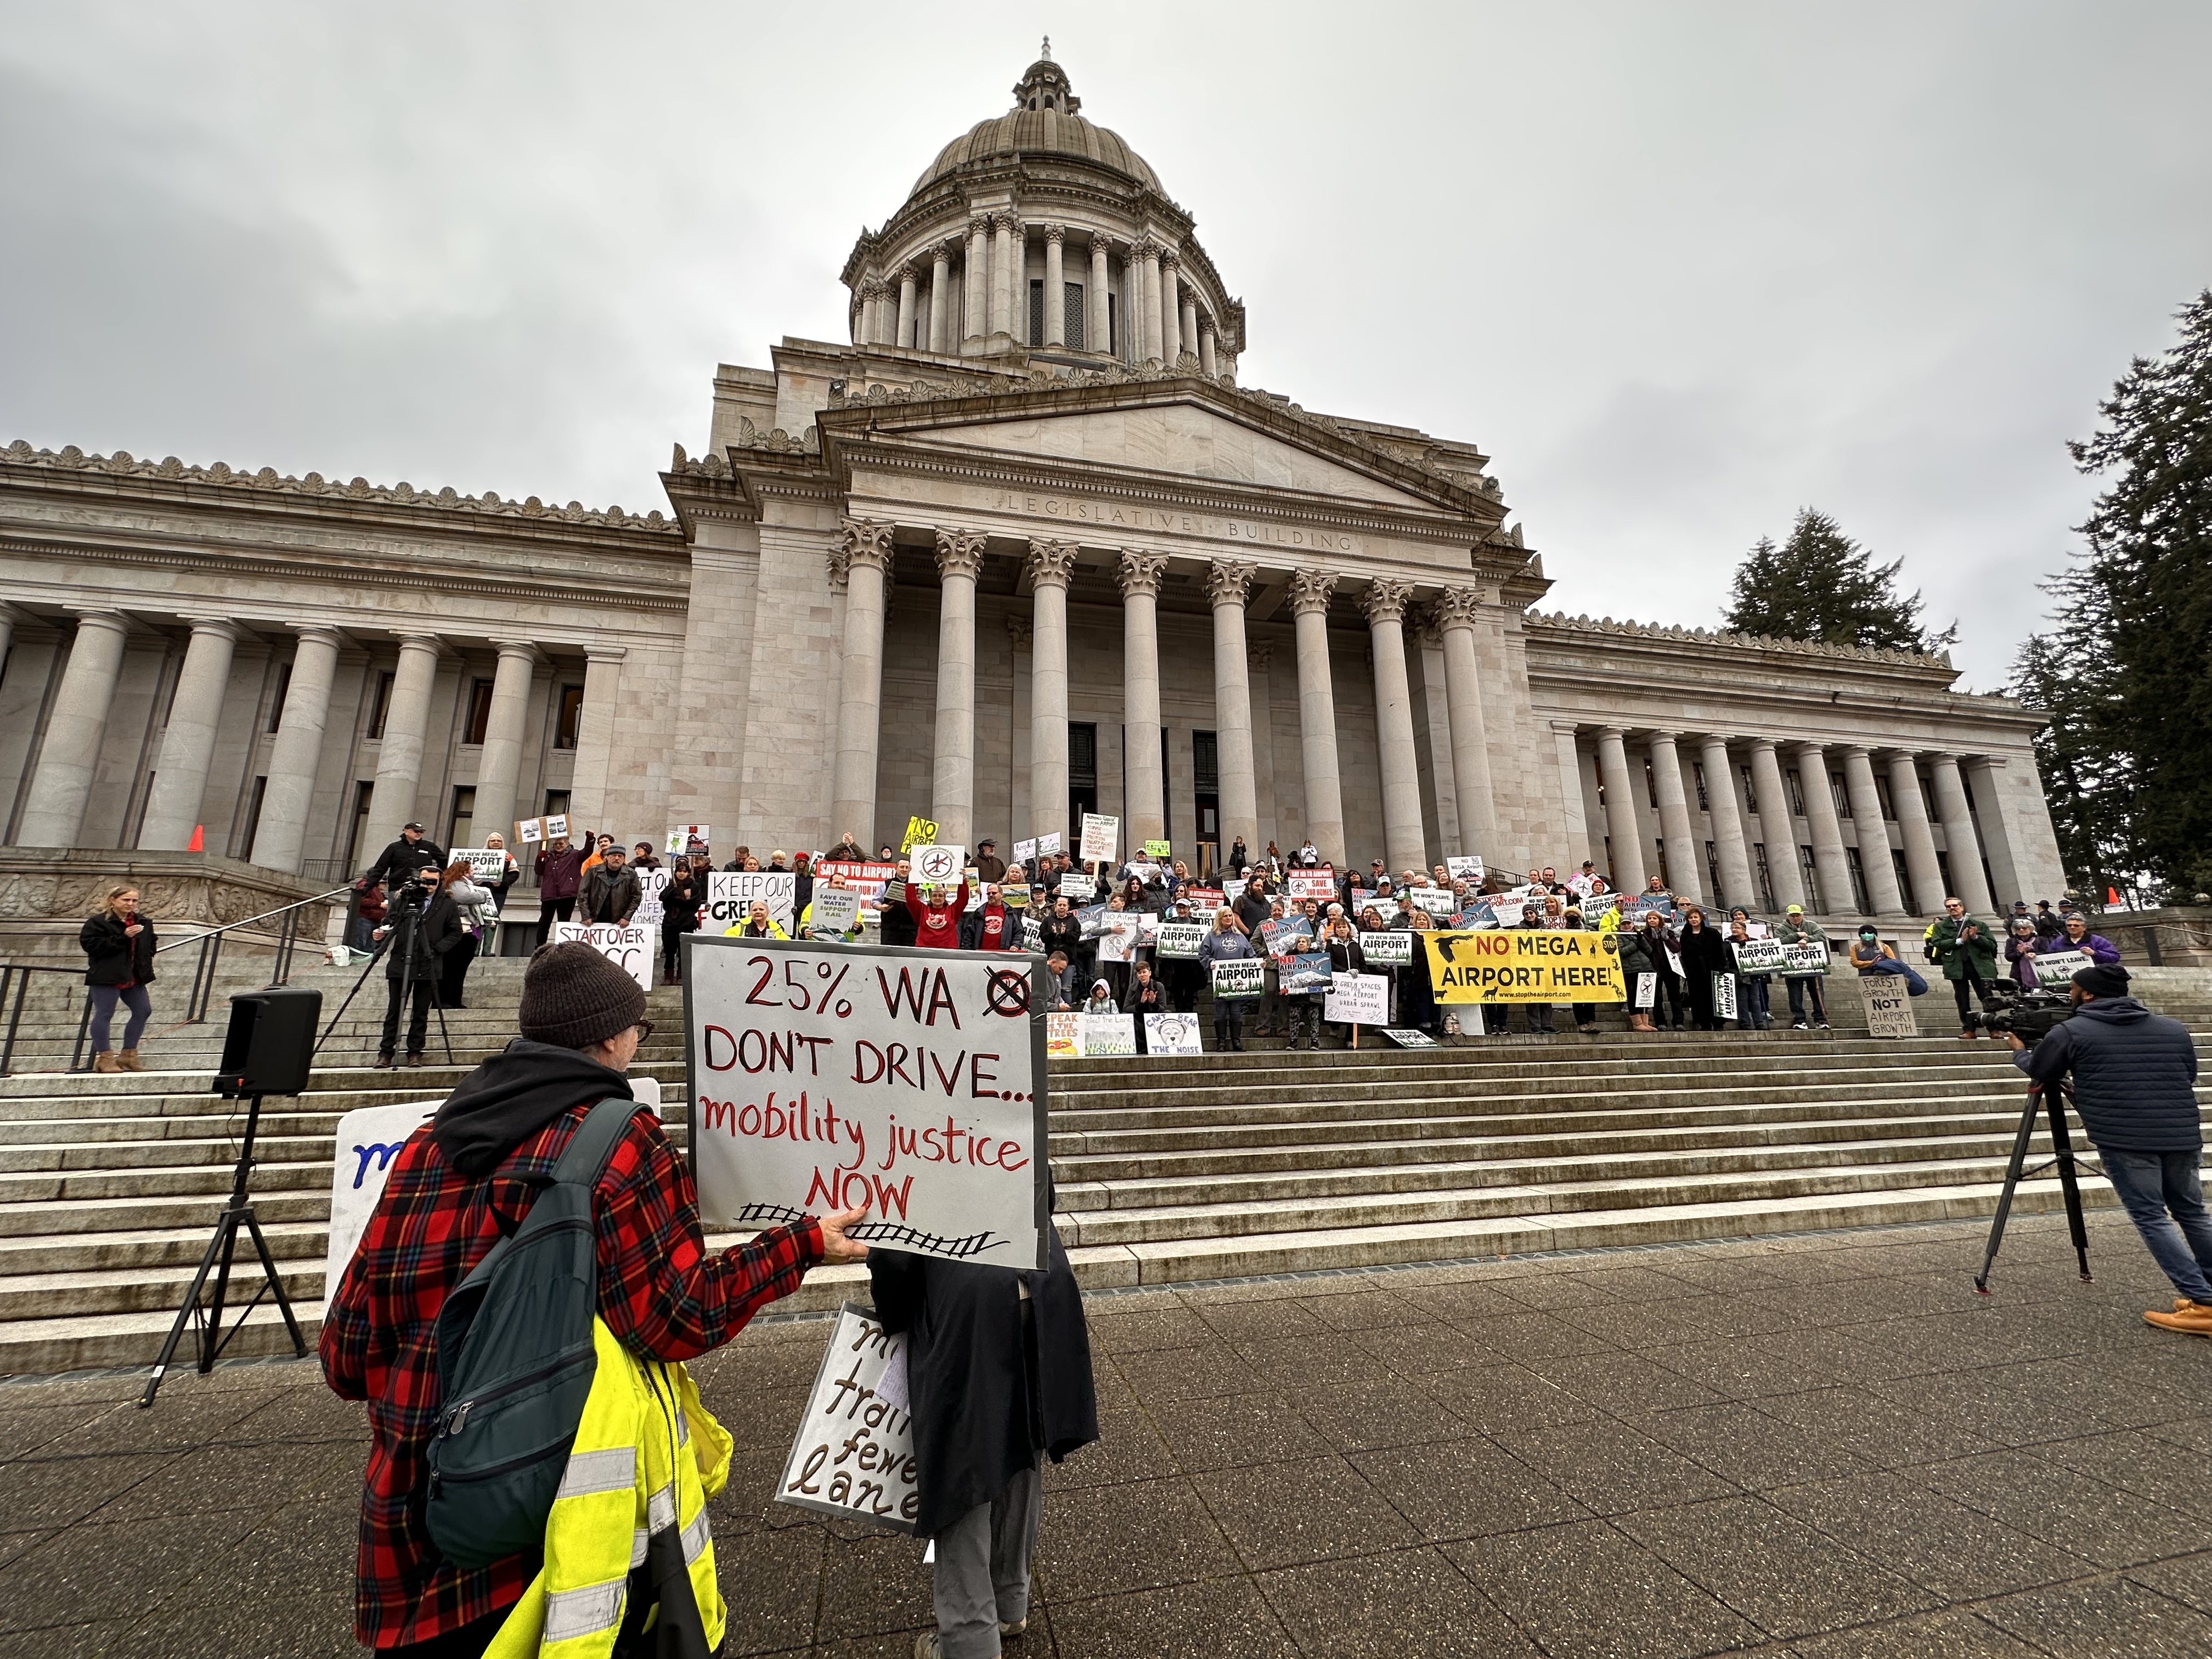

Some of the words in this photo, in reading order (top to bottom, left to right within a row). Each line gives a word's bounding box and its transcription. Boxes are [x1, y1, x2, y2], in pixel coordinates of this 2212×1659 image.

[1007, 494, 1192, 531] LEGISLATIVE
[1229, 523, 1351, 551] BUILDING
[913, 818, 936, 837] NO
[820, 863, 837, 876] SAY
[838, 865, 849, 877] NO
[850, 865, 861, 878] TO
[714, 876, 763, 898] KEEP
[765, 877, 793, 898] OUR
[859, 885, 871, 895] OUR
[711, 900, 768, 921] GRE
[1449, 912, 1464, 924] NO
[1261, 922, 1277, 932] NO
[1265, 926, 1293, 938] AIRPORT
[560, 928, 606, 945] START
[607, 929, 645, 945] OVER
[1160, 932, 1204, 941] AIRPORT
[1363, 940, 1408, 949] AIRPORT
[1476, 935, 1509, 955] NO
[1517, 936, 1582, 956] MEGA
[1603, 940, 1617, 949] STOP
[1738, 946, 1780, 958] AIRPORT
[1279, 956, 1295, 964] NO
[1216, 968, 1261, 980] AIRPORT
[1441, 967, 1544, 986] AIRPORT
[1552, 967, 1611, 986] HERE!
[1863, 977, 1899, 989] FOREST
[745, 956, 853, 1018] 25%
[876, 966, 961, 1030] WA
[1723, 975, 1732, 1015] AIRPORT
[1862, 989, 1904, 998] GROWTH
[1872, 998, 1902, 1011] NOT
[1103, 1015, 1113, 1024] the
[1115, 1015, 1132, 1024] Land
[1177, 1014, 1198, 1028] BEAR
[1870, 1011, 1911, 1023] AIRPORT
[1872, 1023, 1912, 1034] GROWTH
[704, 1024, 833, 1076] DON'T
[699, 1090, 865, 1171] mobility
[878, 1114, 1029, 1171] justice
[804, 1166, 915, 1221] NOW
